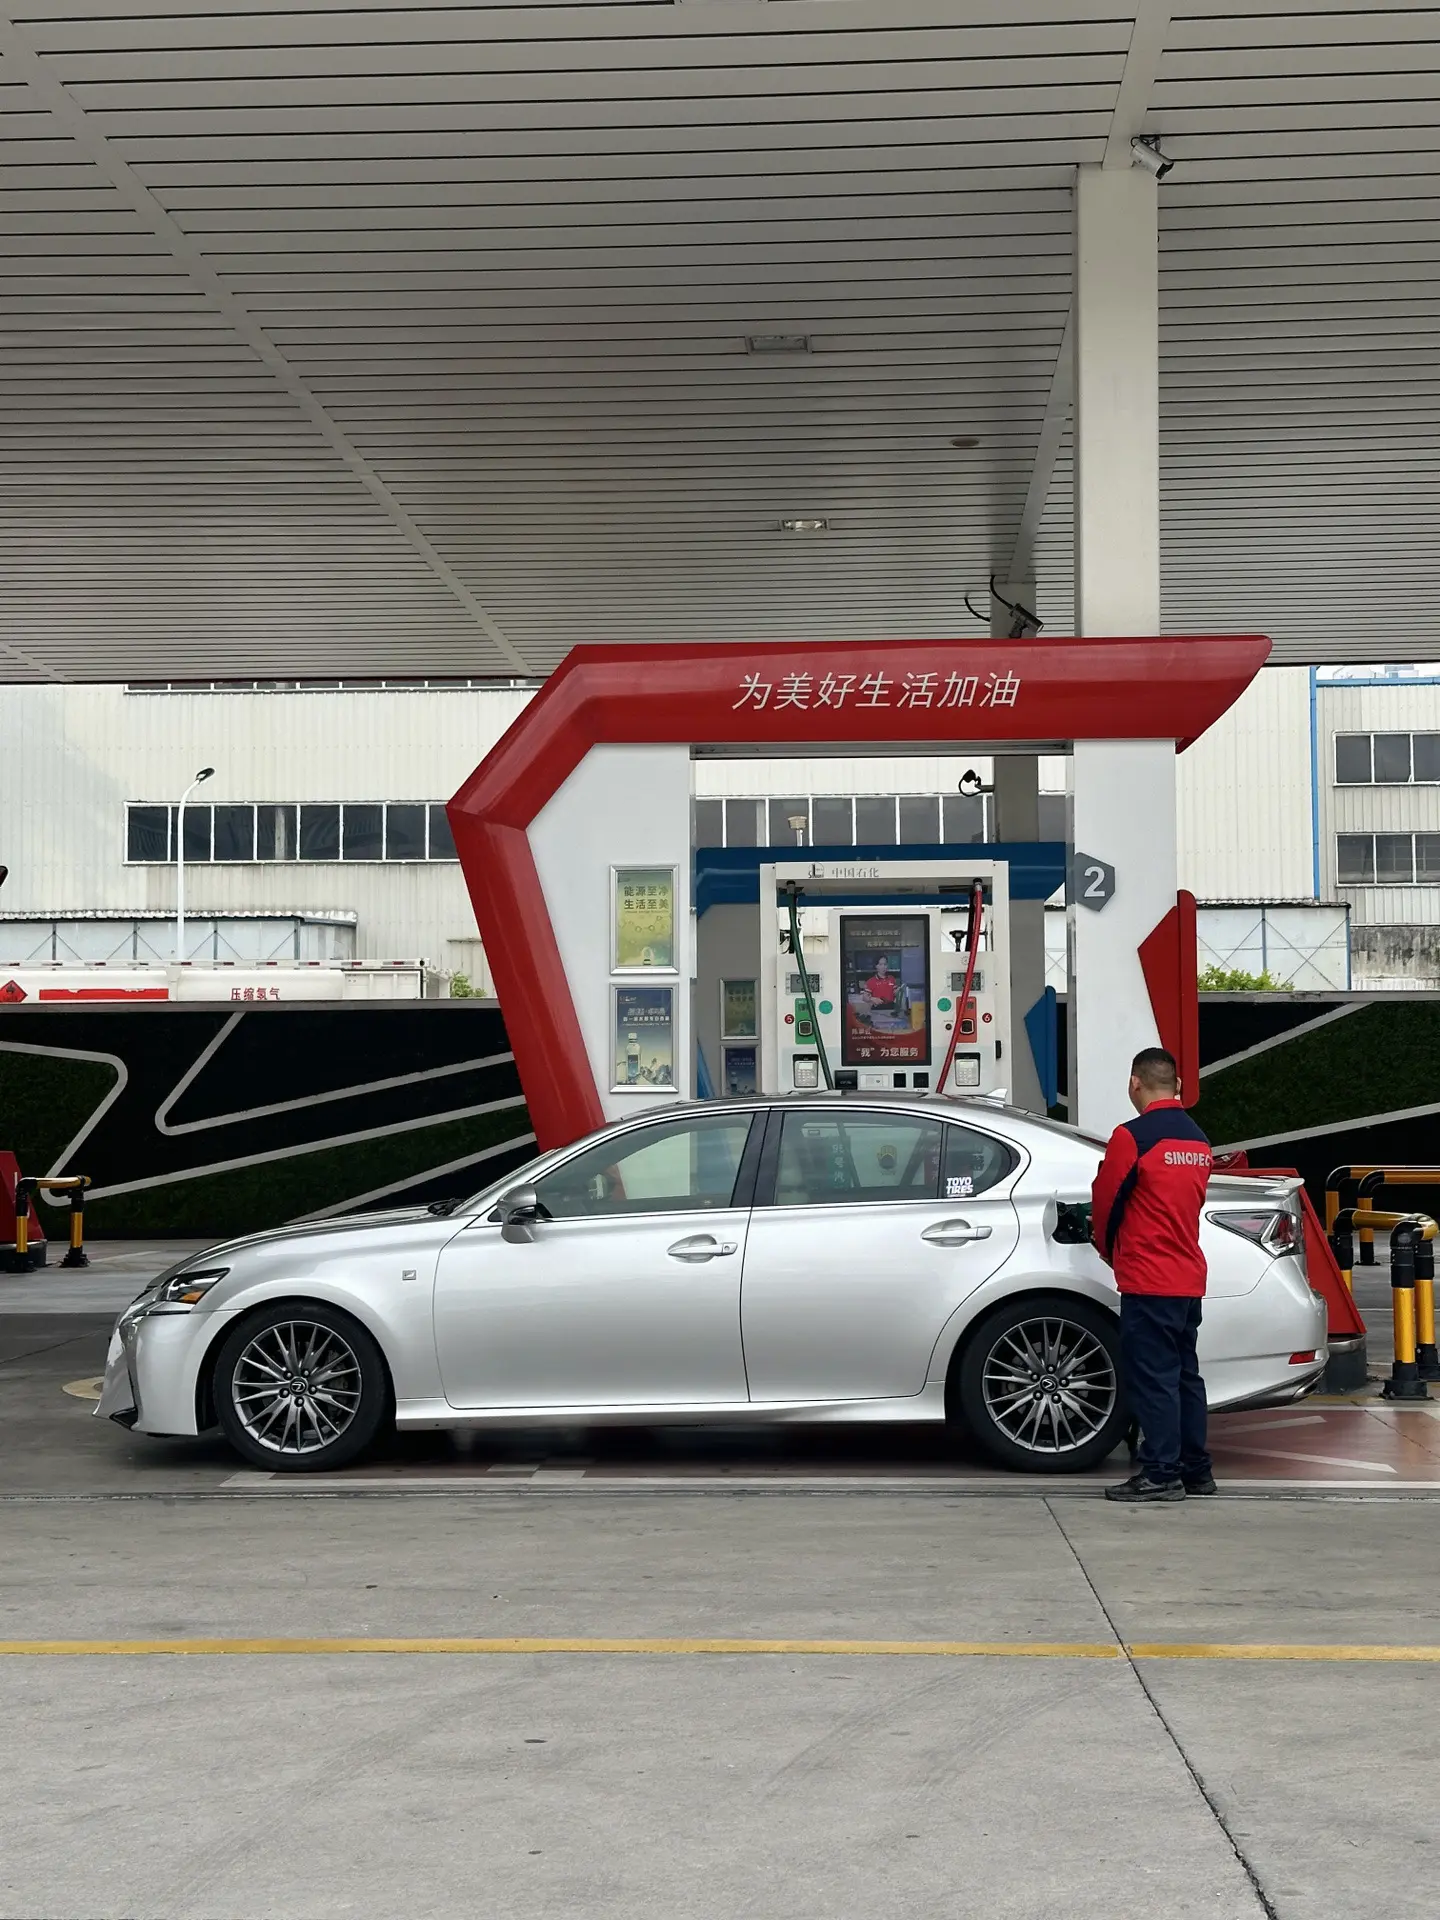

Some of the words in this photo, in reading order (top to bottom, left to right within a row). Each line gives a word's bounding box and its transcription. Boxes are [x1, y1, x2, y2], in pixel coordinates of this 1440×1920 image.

[731, 670, 1022, 710] 为美好生活加油
[831, 867, 880, 878] 中国石化
[1083, 866, 1107, 898] 2
[624, 898, 669, 910] 生活至美
[231, 987, 280, 1001] 压缩氢气
[1164, 1151, 1211, 1167] SINOPEC
[946, 1176, 972, 1186] TOYO
[946, 1185, 973, 1195] TIRES
